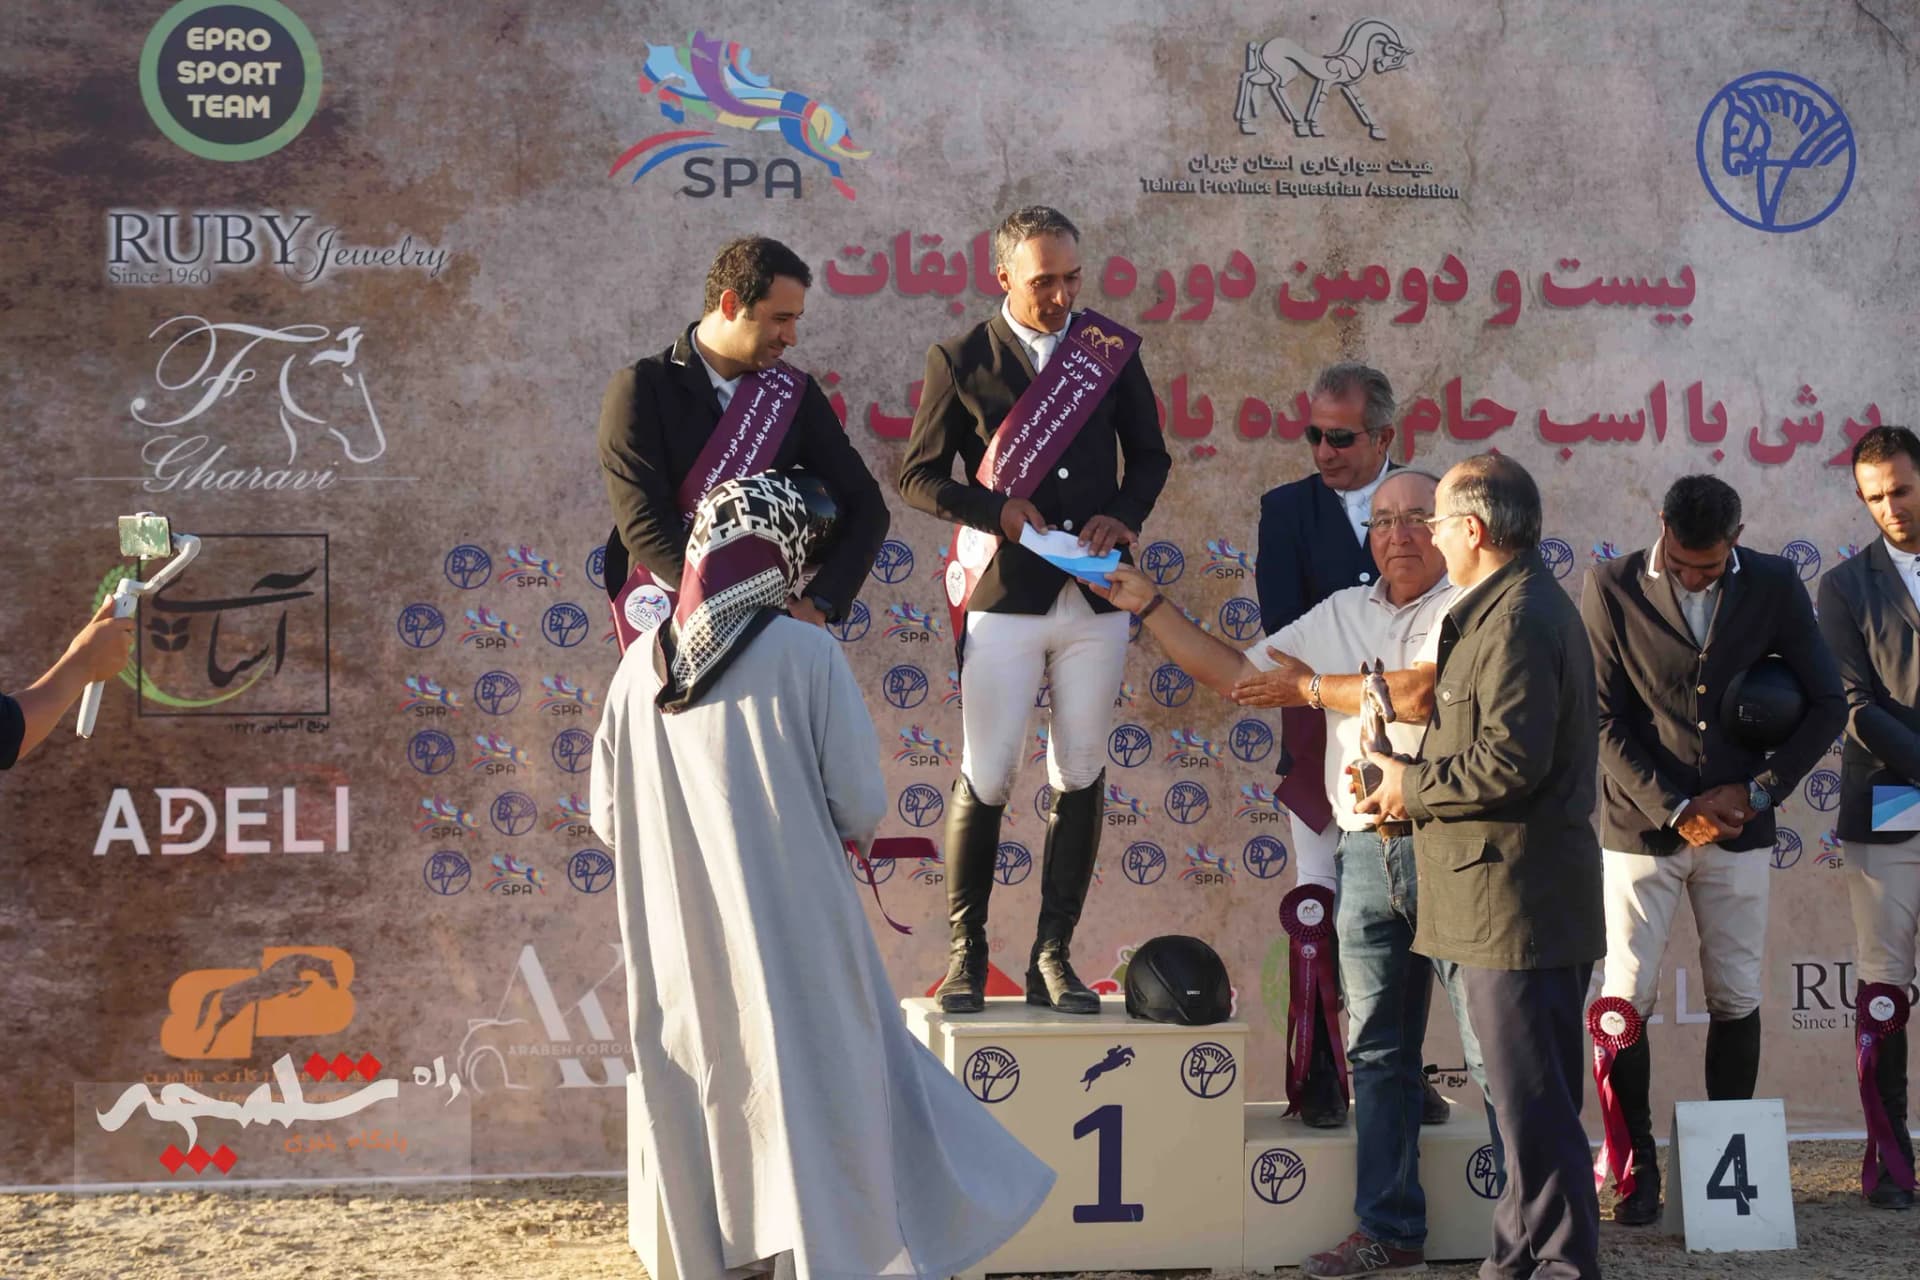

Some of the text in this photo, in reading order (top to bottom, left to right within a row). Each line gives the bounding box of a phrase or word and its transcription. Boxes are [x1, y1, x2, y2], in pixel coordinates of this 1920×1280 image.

[187, 27, 271, 52] EPRO
[177, 61, 282, 85] SPORT
[187, 94, 271, 119] TEAM
[1188, 154, 1239, 174] تهران
[1242, 155, 1293, 173] استان
[1301, 156, 1382, 176] سوارکاری
[682, 157, 803, 199] SPA
[1140, 178, 1460, 199] Tehran Province Equestrian Association
[108, 212, 452, 284] RUBY Jewelry
[108, 267, 213, 286] Since 1960
[825, 229, 1696, 325] بیست و دومین دوره ابقات
[1070, 350, 1087, 368] اول
[1053, 375, 1070, 397] بیست
[1072, 387, 1087, 407] جام
[1031, 400, 1049, 427] دومین
[1059, 402, 1078, 421] زنده
[1538, 379, 1668, 462] اسب
[1687, 380, 1728, 464] با
[1014, 423, 1031, 445] دوره
[1036, 428, 1054, 451] استاد
[141, 435, 338, 492] Gharavi
[517, 576, 548, 588] SPA
[1216, 568, 1245, 580] SPA
[475, 638, 507, 649] SPA
[899, 631, 930, 644] SPA
[415, 706, 447, 718] SPA
[552, 705, 583, 717] SPA
[306, 718, 331, 735] برنج
[486, 764, 516, 776] SPA
[909, 755, 940, 767] SPA
[1180, 757, 1209, 769] SPA
[93, 786, 349, 856] ADELI
[1108, 814, 1137, 826] SPA
[1250, 812, 1279, 824] SPA
[431, 827, 463, 839] SPA
[1829, 857, 1844, 869] SP
[924, 874, 944, 886] SP
[1194, 873, 1224, 885] SPA
[501, 884, 533, 896] SPA
[1792, 1012, 1837, 1030] Since
[508, 1044, 571, 1057] ARABEH
[1072, 1104, 1145, 1224] 1
[1706, 1133, 1758, 1216] 4
